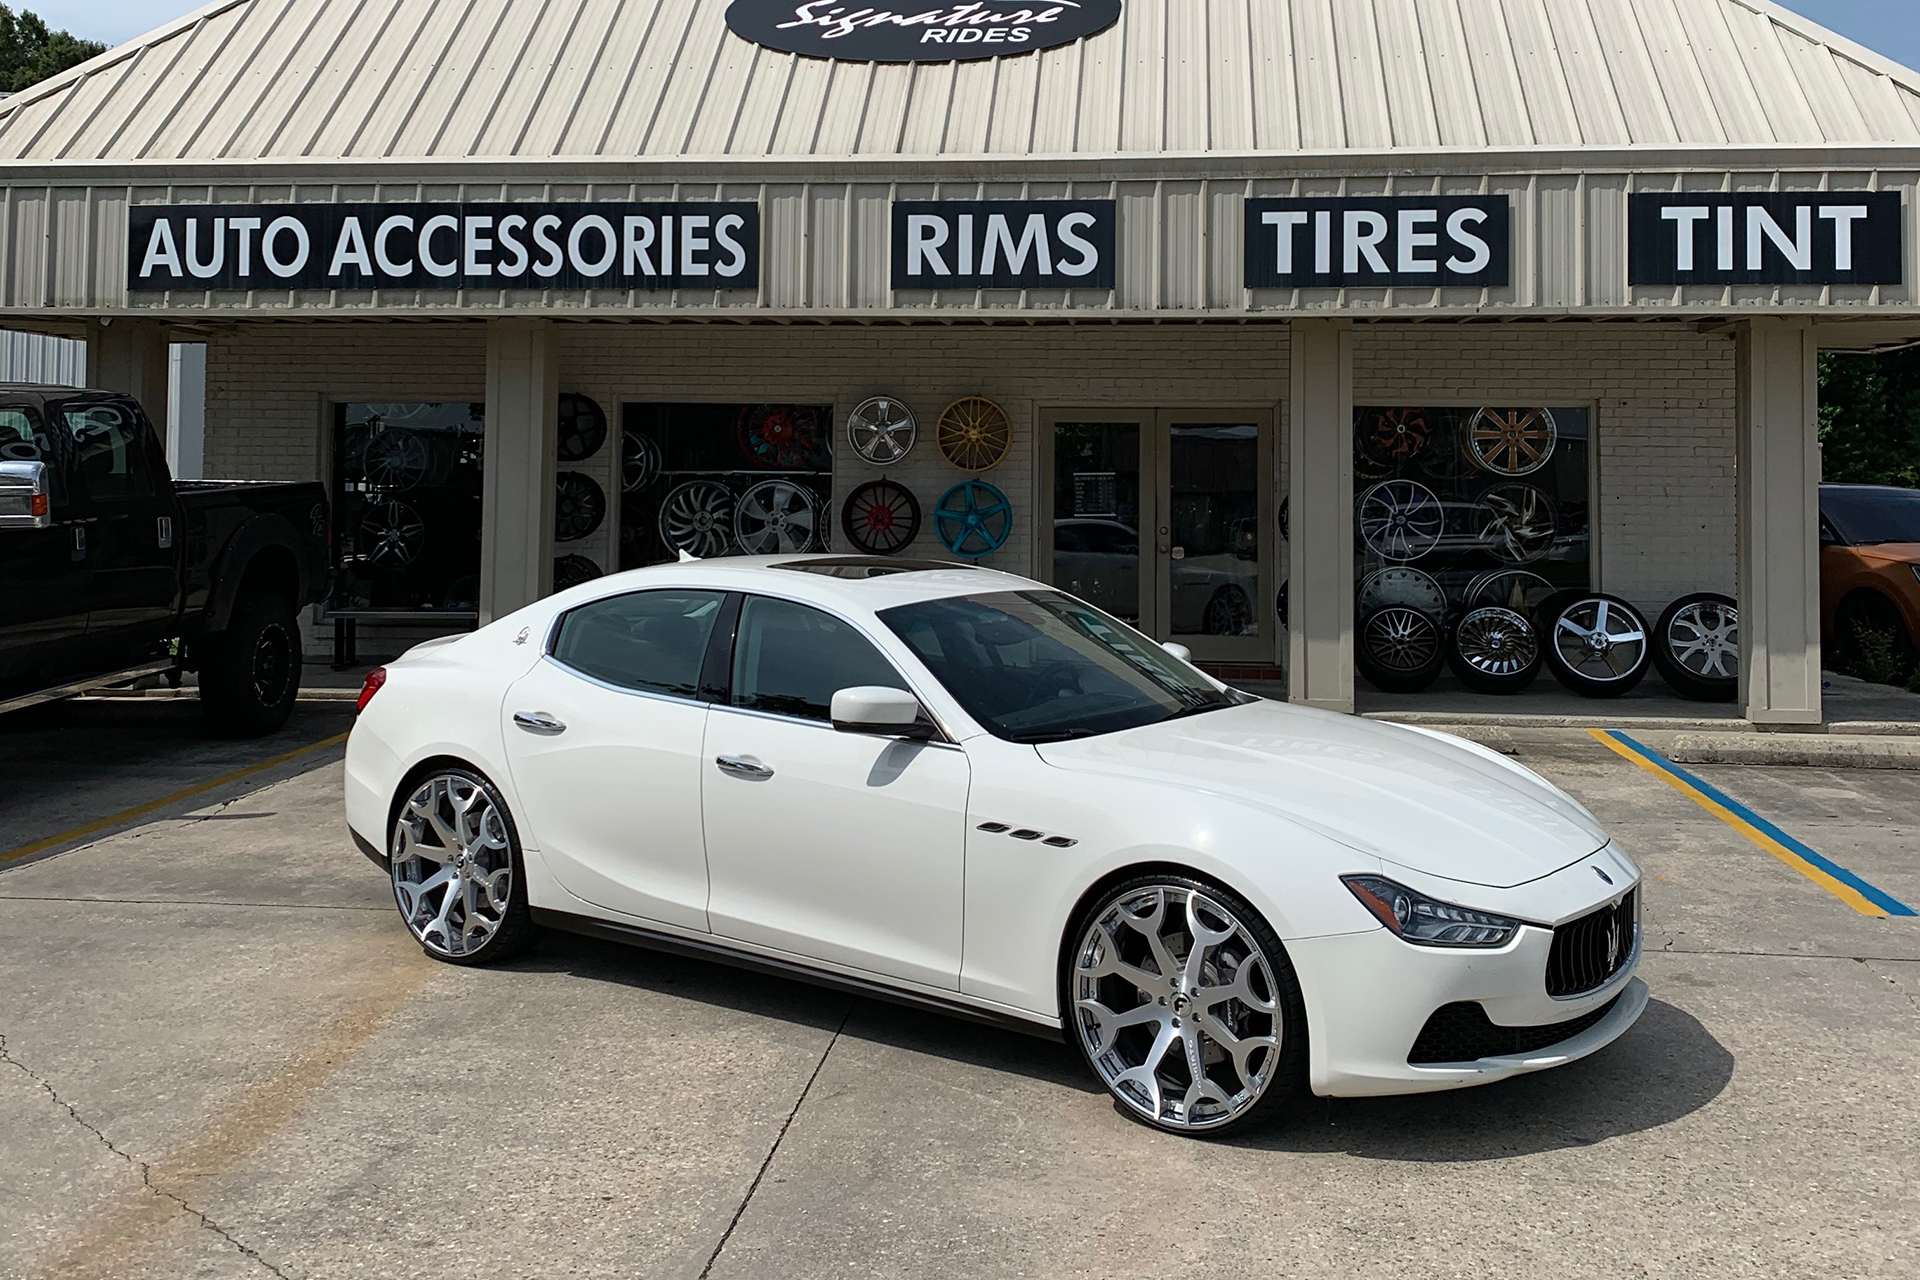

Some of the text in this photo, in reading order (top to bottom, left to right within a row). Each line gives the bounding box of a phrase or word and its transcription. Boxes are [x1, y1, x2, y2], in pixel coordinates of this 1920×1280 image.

[775, 0, 1065, 39] Signature
[919, 27, 1032, 44] RIDES
[139, 214, 747, 278] AUTO ACCESSORIES
[907, 212, 1098, 276] RIMS
[1261, 207, 1490, 274] TIRES
[1661, 205, 1868, 271] TINT
